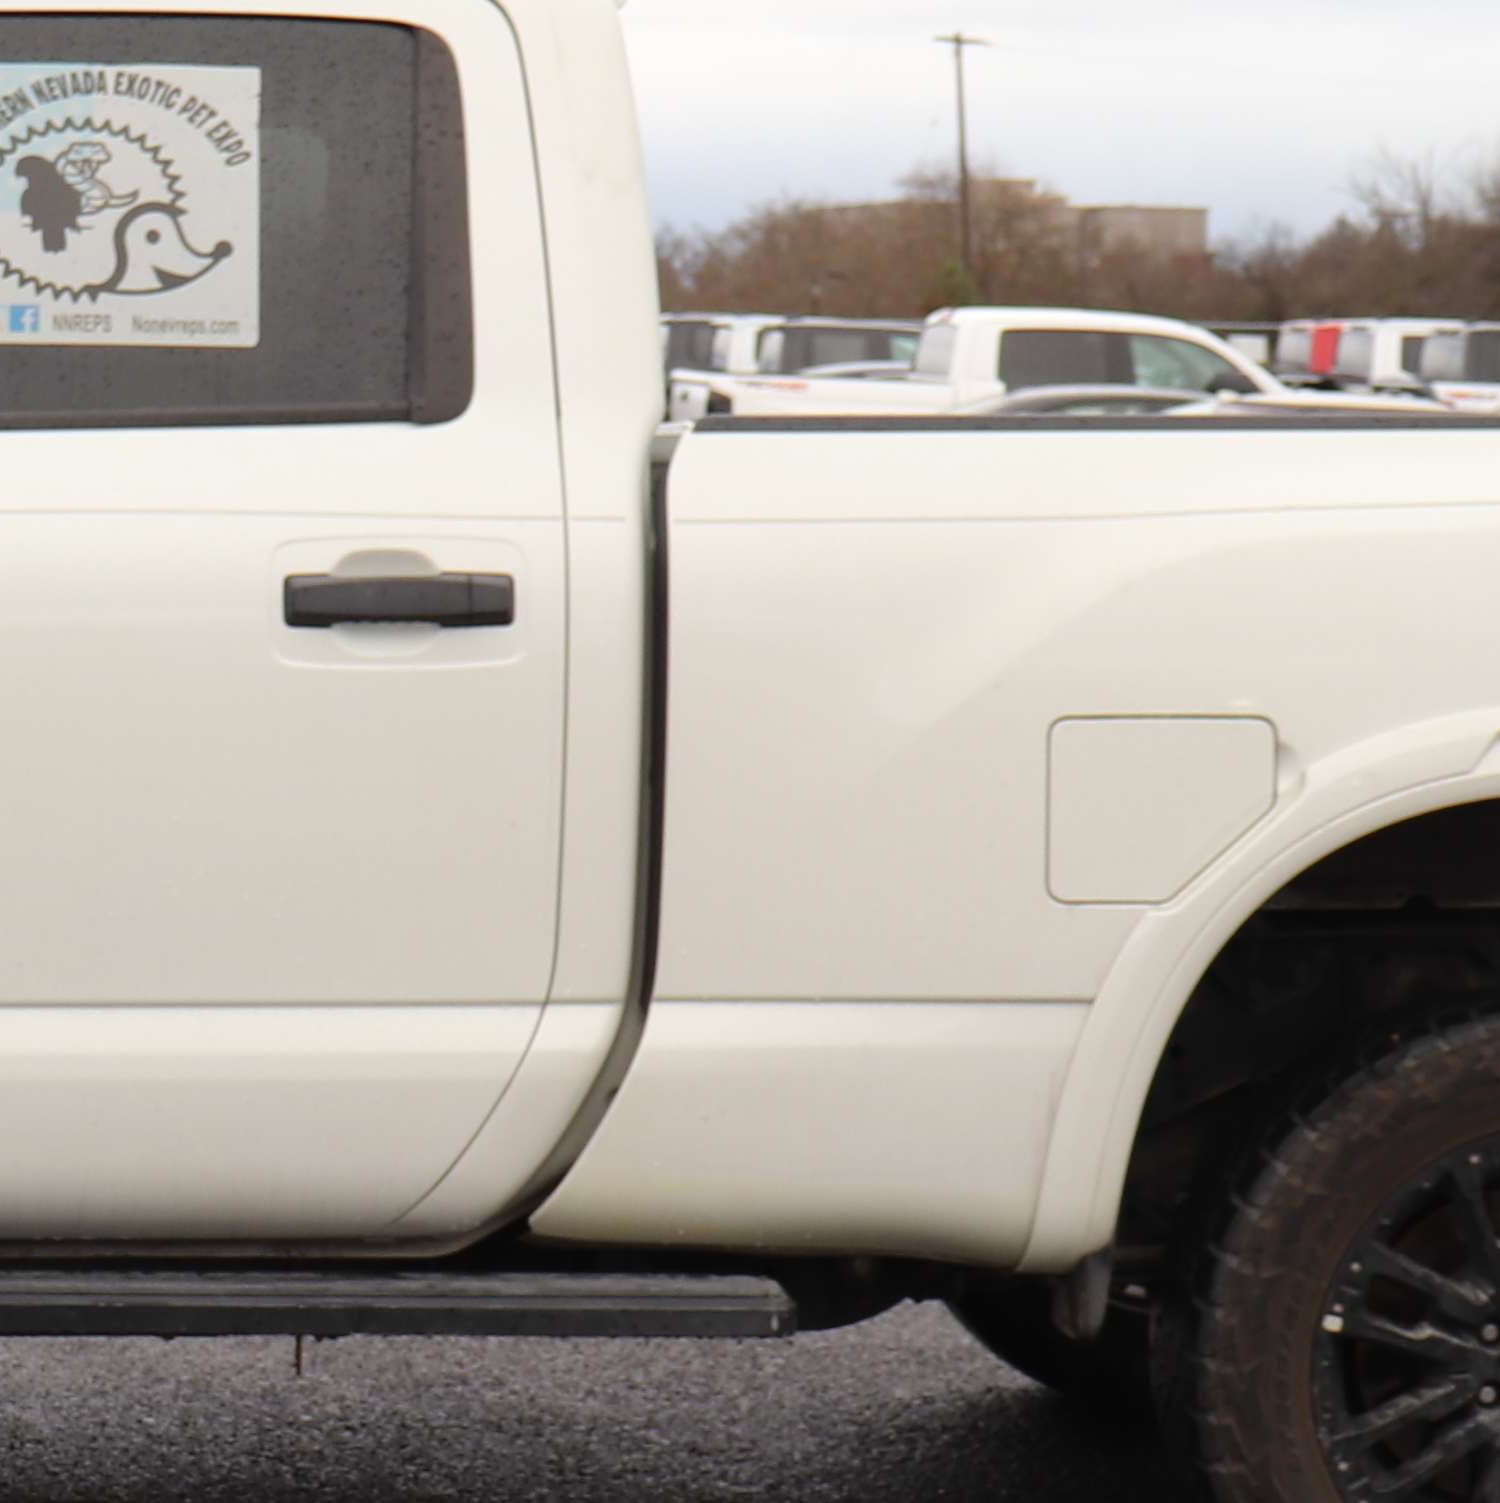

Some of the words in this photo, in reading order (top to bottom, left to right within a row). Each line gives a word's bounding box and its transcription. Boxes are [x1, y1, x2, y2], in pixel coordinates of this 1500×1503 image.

[30, 70, 107, 102] NEVADA
[113, 70, 182, 110] EXOTIC
[177, 95, 219, 129] PET
[205, 119, 252, 167] EXPO
[53, 312, 113, 332] NNREPS
